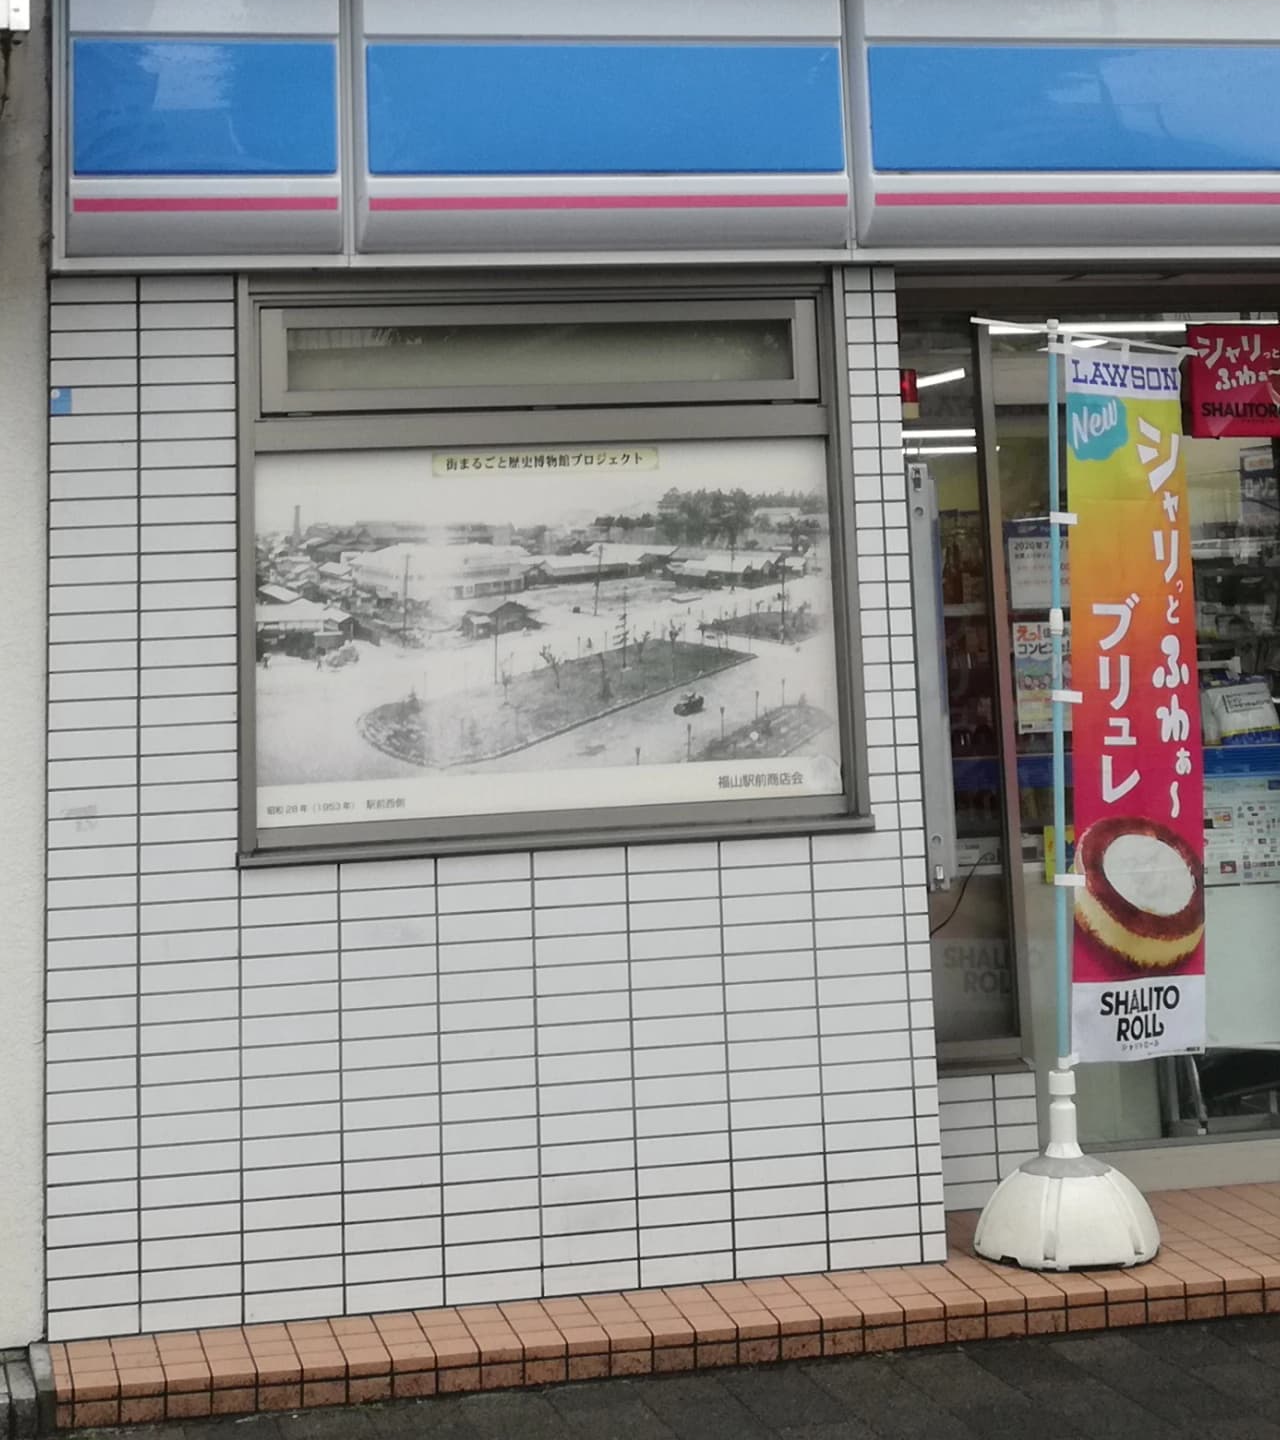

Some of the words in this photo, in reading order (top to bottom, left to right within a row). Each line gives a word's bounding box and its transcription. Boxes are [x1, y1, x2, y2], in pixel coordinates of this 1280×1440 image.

[1071, 359, 1179, 392] LAWSON
[1072, 399, 1119, 450] New
[446, 451, 644, 471] 街まるごと歴史博物館プロジェクト
[1091, 592, 1142, 804] ブリュレ
[1100, 985, 1180, 1016] SHALITO
[1116, 1013, 1165, 1042] ROLL
